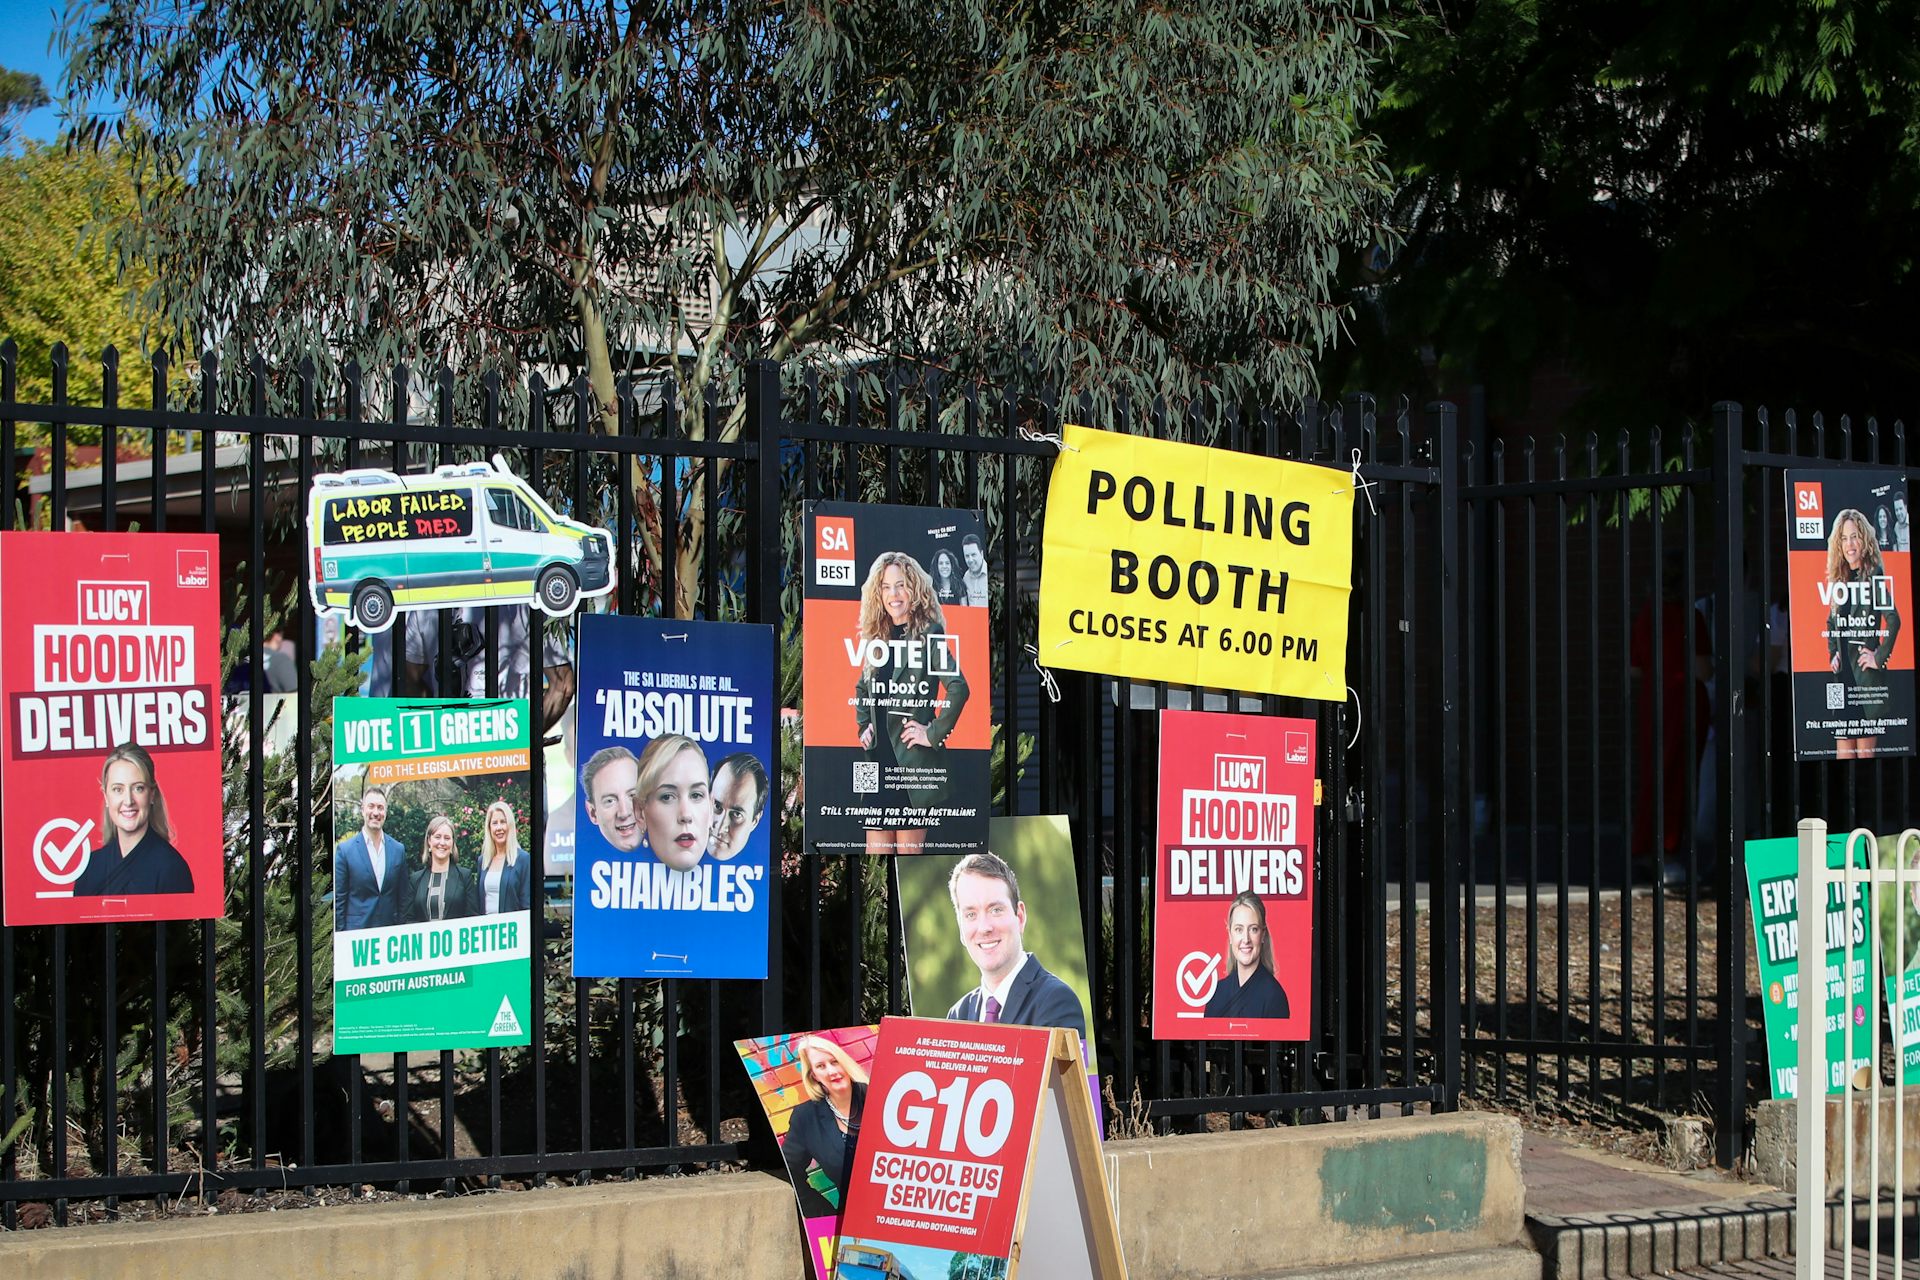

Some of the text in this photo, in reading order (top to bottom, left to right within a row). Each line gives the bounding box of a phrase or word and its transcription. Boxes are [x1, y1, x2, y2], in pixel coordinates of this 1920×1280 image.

[332, 494, 466, 522] LABOR FAILED.
[1087, 470, 1310, 546] POLLING
[1799, 490, 1818, 510] SA
[342, 518, 460, 542] PEOPLE DIED.
[821, 526, 849, 551] SA
[1800, 522, 1820, 534] BEST
[179, 574, 207, 585] Labor
[820, 566, 850, 580] BEST
[1111, 549, 1288, 614] BOOTH
[86, 589, 142, 621] LUCY
[1817, 581, 1886, 605] VOTE 1
[1837, 614, 1875, 627] in box C
[1068, 610, 1318, 662] CLOSES AT 6.00 PM
[44, 634, 186, 683] HOOD MP
[844, 638, 948, 669] VOTE 1
[624, 671, 739, 692] THE SA LIBERALS ARE AN...
[872, 678, 929, 695] in box C
[862, 698, 875, 706] THE
[902, 699, 928, 708] BALLOT
[930, 700, 951, 708] PAPER
[20, 690, 208, 753] DELIVERS
[344, 708, 519, 754] VOTE 1 GREENS
[373, 754, 528, 778] FOR THE LEGISLATIVE COUNCIL
[1287, 753, 1306, 761] Labor
[1220, 761, 1261, 790] LUCY
[883, 818, 906, 826] PARTY
[902, 807, 926, 816] SOUTH
[1190, 798, 1289, 842] HOOD MP
[1170, 849, 1303, 896] DELIVERS
[352, 922, 518, 968] WE CAN DO BETTER
[346, 972, 465, 997] FOR SOUTH AUSTRALIA
[494, 1022, 517, 1032] GREENS
[500, 1012, 511, 1021] THE
[895, 1047, 916, 1055] LABOR
[916, 1048, 960, 1060] GOVERNMENT
[960, 1053, 975, 1061] AND
[976, 1054, 993, 1063] LUCY
[993, 1056, 1012, 1064] HOOD
[922, 1038, 959, 1049] RE-ELECTED
[959, 1041, 1005, 1052] MALINAUSKAS
[941, 1062, 967, 1072] DELIVER
[973, 1065, 988, 1073] NEW
[882, 1071, 1014, 1158] G10
[875, 1156, 999, 1191] SCHOOL BUS
[890, 1184, 972, 1214] SERVICE
[876, 1216, 977, 1236] TO ADELAIDE AND BOTANIC HIGH
